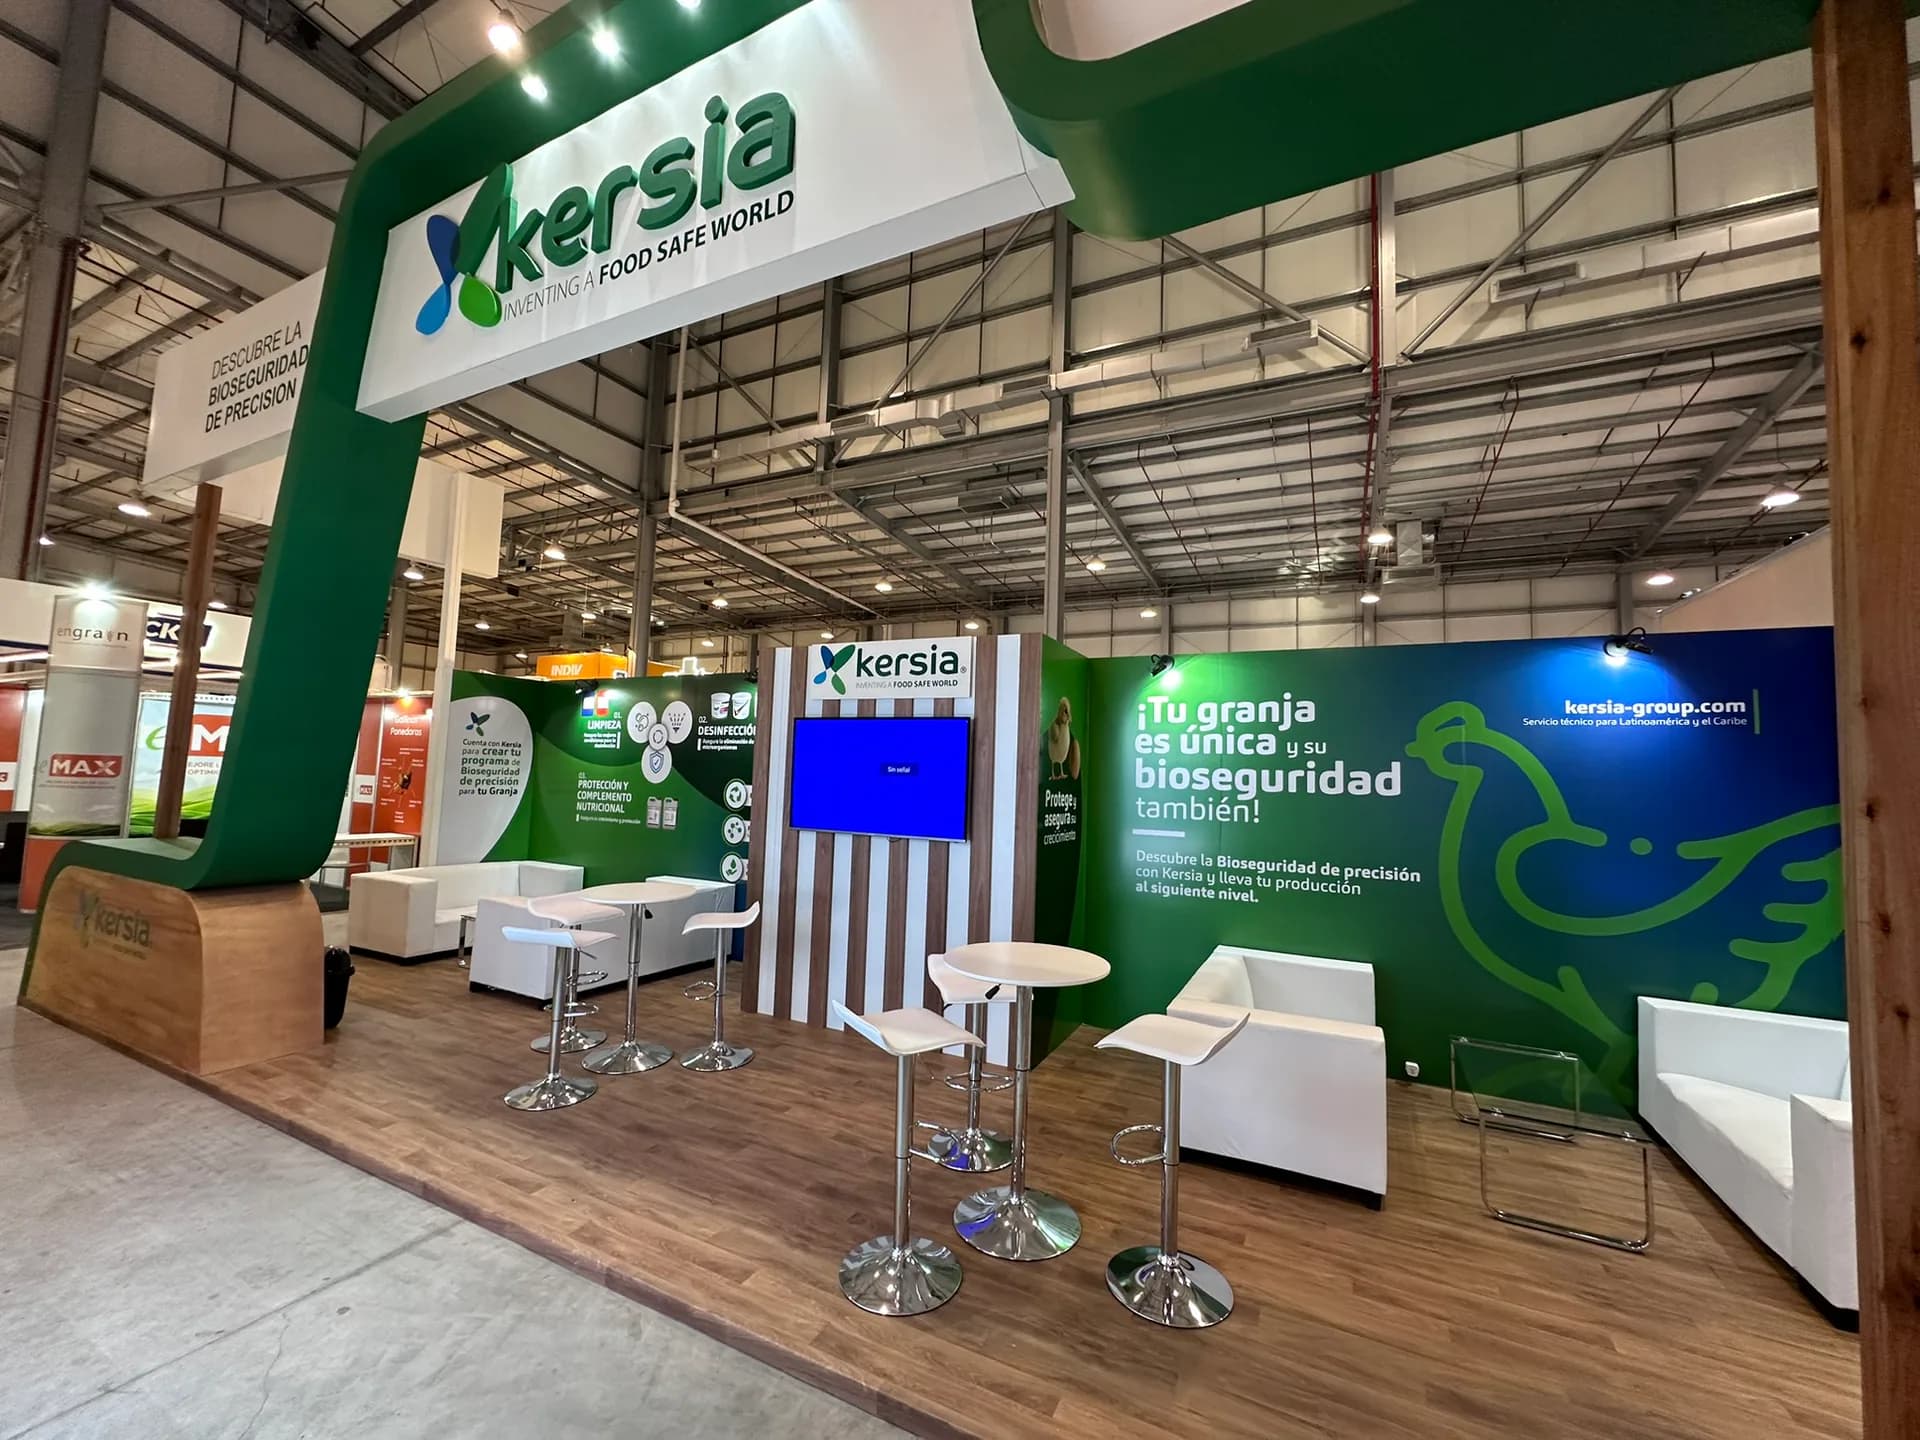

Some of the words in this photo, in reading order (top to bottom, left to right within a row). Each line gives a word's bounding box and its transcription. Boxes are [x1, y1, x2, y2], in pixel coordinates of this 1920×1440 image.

[495, 92, 796, 293] kersia
[503, 275, 580, 322] INVENTING
[583, 269, 596, 290] A
[599, 245, 652, 285] FOOD
[657, 224, 706, 263] SAFE
[710, 189, 794, 240] WORLD
[211, 329, 282, 380] DESCUBRE
[284, 320, 302, 346] LA
[208, 344, 309, 406] BIOSEGURIDAD
[205, 410, 223, 433] DE
[224, 378, 297, 425] PRECISION
[893, 680, 913, 689] FOOD
[914, 680, 931, 688] SAFE
[932, 679, 959, 688] WORLD
[1137, 695, 1187, 730] ¡Tu
[1197, 692, 1316, 732] granja
[1564, 699, 1747, 718] kersia-group.com
[587, 720, 621, 730] LIMPIEZA
[1523, 717, 1559, 726] Servicio
[1560, 716, 1594, 726] técnico
[1596, 718, 1618, 727] para
[1619, 716, 1690, 726] Latinoamérica
[1692, 718, 1700, 727] y
[1701, 717, 1711, 726] el
[1713, 716, 1748, 726] Caribe
[462, 738, 487, 747] Cuenta
[501, 741, 522, 749] Kersia
[1135, 733, 1170, 754] es
[1180, 725, 1276, 755] única
[1286, 741, 1298, 758] y
[1304, 741, 1327, 754] su
[462, 748, 480, 756] para
[482, 748, 509, 756] crear
[511, 748, 521, 757] tu
[51, 759, 117, 775] MAX
[461, 757, 510, 767] programa
[460, 766, 520, 777] Bioseguridad
[1135, 757, 1401, 801] bioseguridad
[460, 776, 473, 786] de
[474, 776, 519, 788] precisión
[577, 779, 622, 790] PROTECCIÓN
[623, 781, 629, 790] Y
[459, 788, 475, 796] para
[477, 787, 488, 795] tu
[489, 787, 518, 797] Granja
[576, 790, 632, 802] COMPLEMENTO
[1045, 789, 1073, 811] Protege
[576, 802, 625, 813] NUTRICIONAL
[1136, 796, 1260, 823] también!
[1044, 812, 1071, 830] asegura
[1136, 850, 1197, 866] Descubre
[1201, 853, 1213, 867] la
[1217, 856, 1317, 875] Bioseguridad
[1320, 862, 1340, 876] de
[1344, 865, 1421, 882] precisión
[1136, 868, 1159, 879] con
[1162, 867, 1201, 882] Kersia
[1207, 873, 1216, 886] y
[1219, 871, 1252, 886] lleva
[1256, 875, 1271, 888] tu
[1275, 878, 1361, 896] producción
[1135, 881, 1148, 893] al
[1151, 884, 1216, 899] siguiente
[1218, 888, 1259, 903] nivel.
